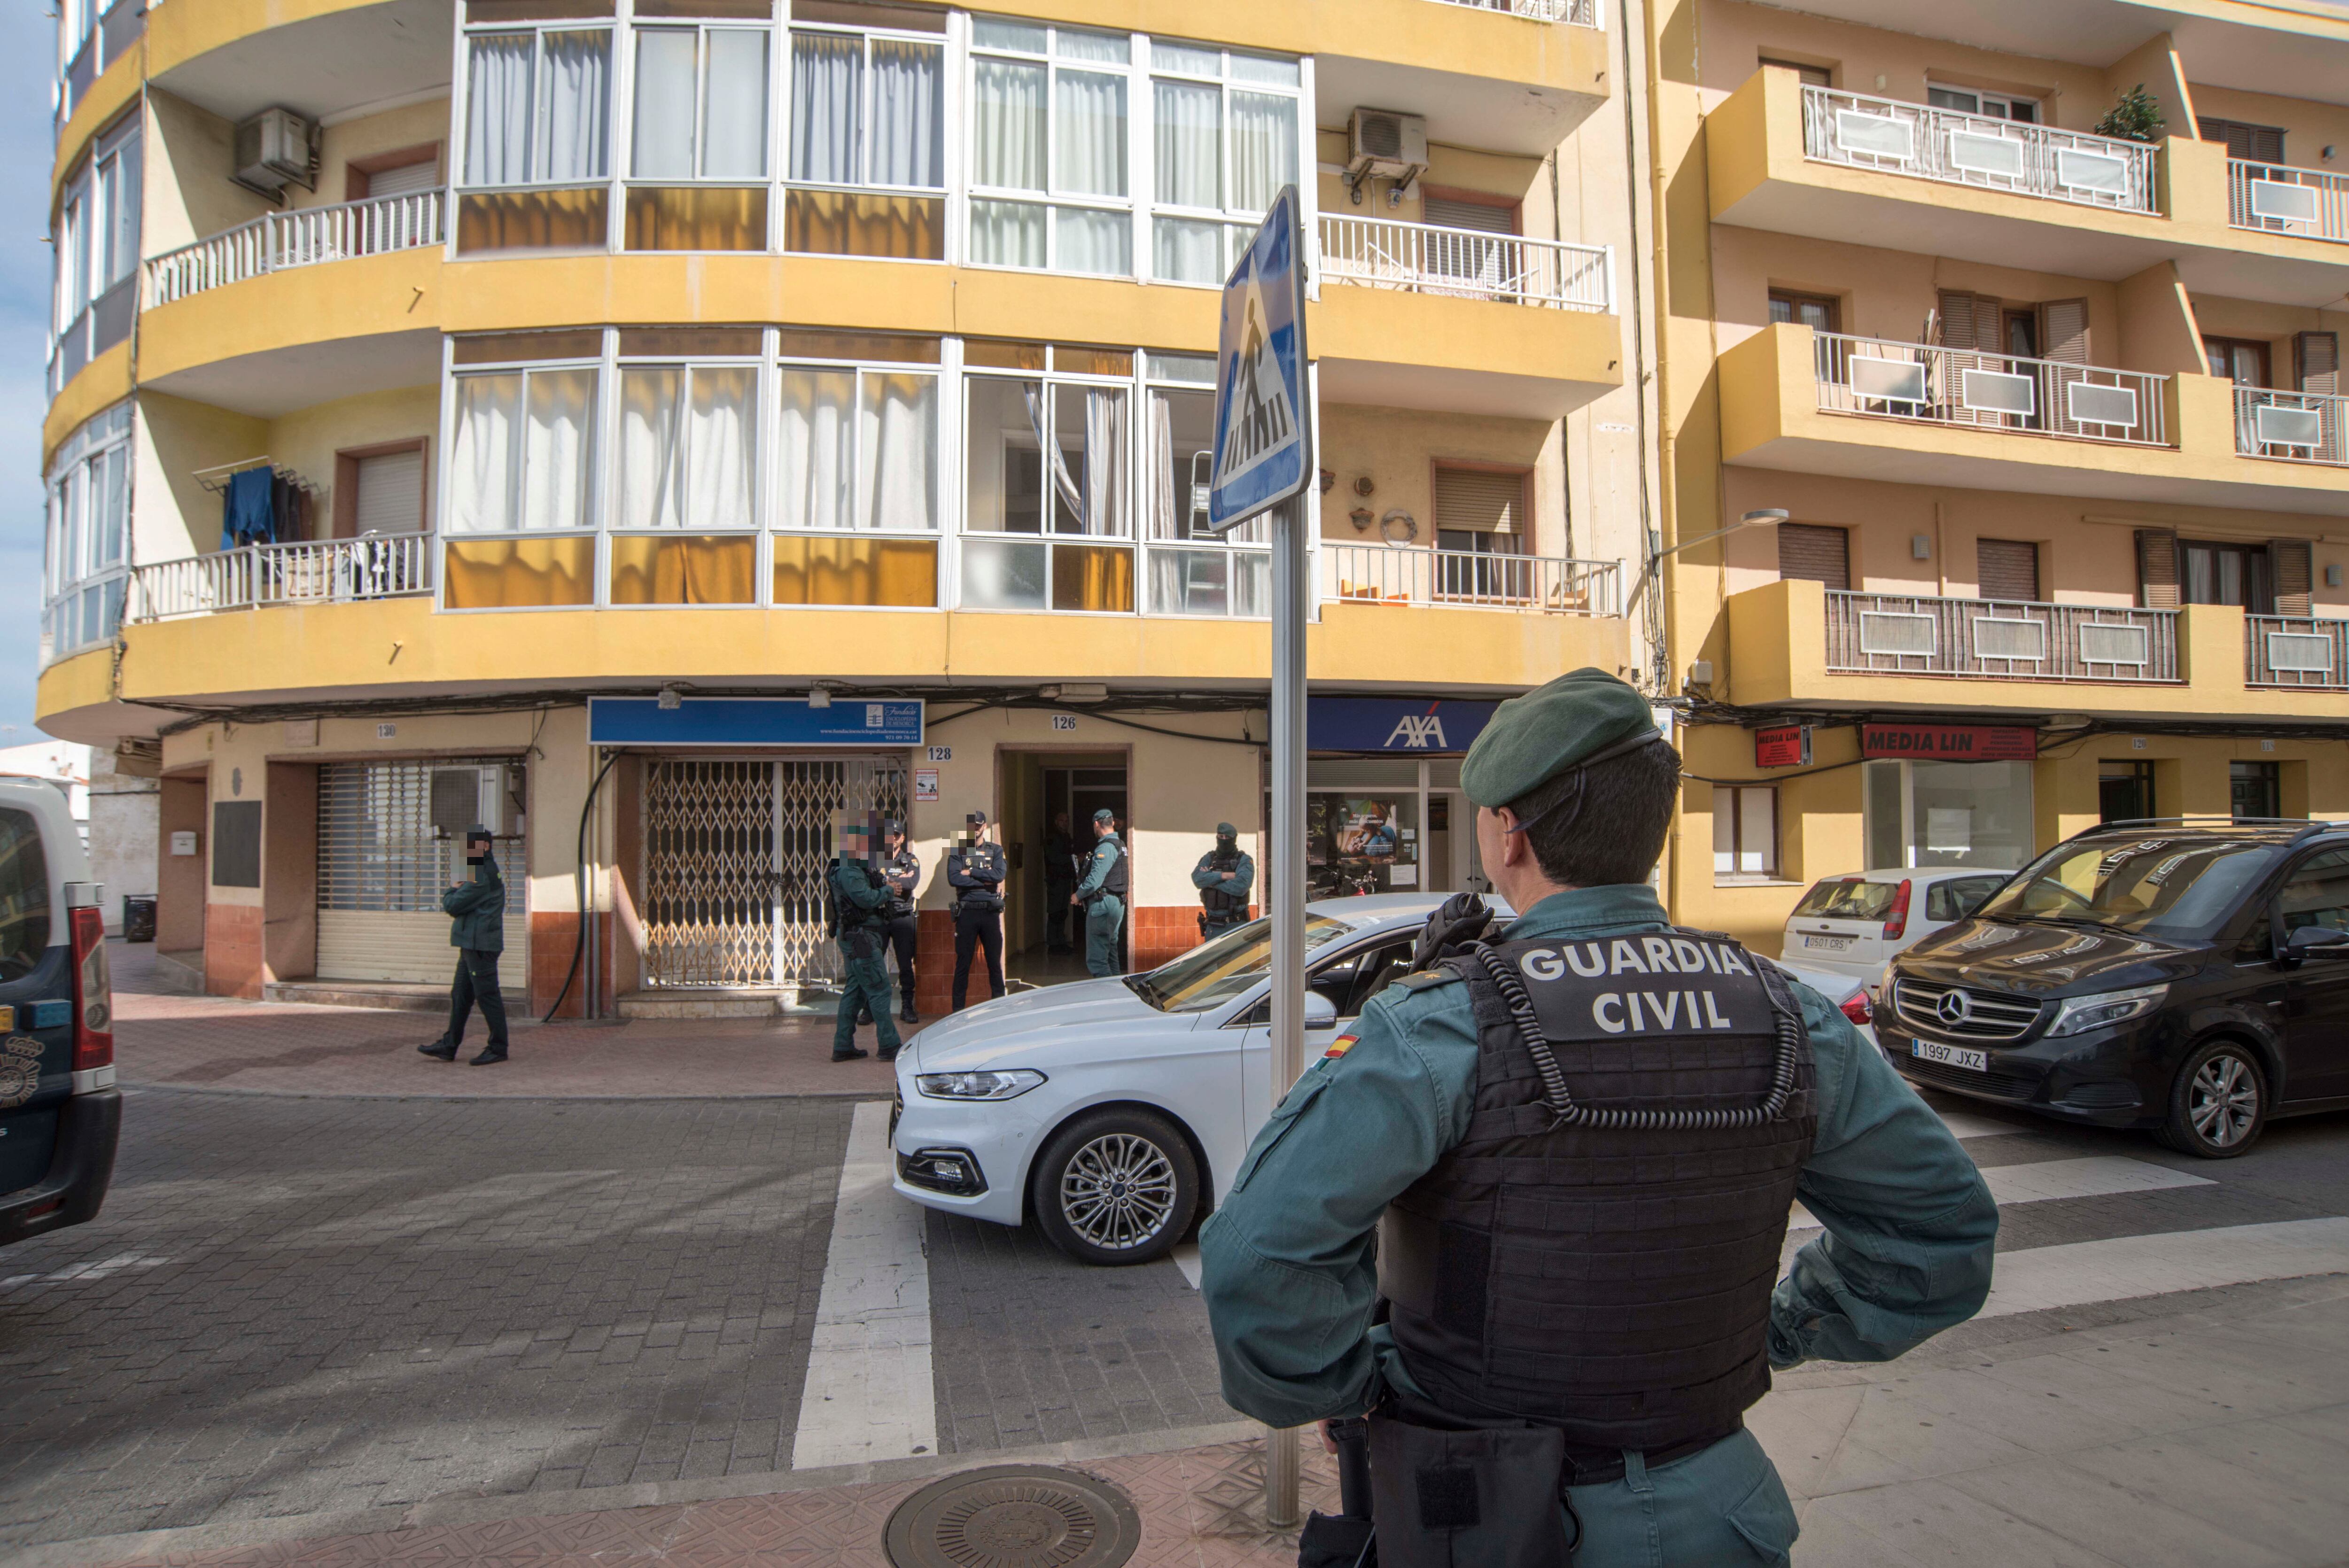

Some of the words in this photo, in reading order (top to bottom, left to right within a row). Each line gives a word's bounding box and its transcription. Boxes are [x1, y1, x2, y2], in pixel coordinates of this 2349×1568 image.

[885, 705, 918, 715] Fundació
[1053, 716, 1075, 729] 126
[379, 725, 395, 737] 130
[1383, 715, 1447, 747] AXA
[1758, 734, 1783, 744] MEDIA
[1786, 732, 1799, 741] LIN
[1867, 732, 1934, 751] MEDIA
[1940, 733, 1972, 751] LIN
[2133, 738, 2146, 748] 120
[928, 747, 951, 760] 128
[1810, 938, 1827, 947] 0501
[1830, 939, 1843, 948] CRS
[1520, 938, 1753, 980] GUARDIA
[1593, 991, 1731, 1033] CIVIL
[1923, 1043, 1951, 1061] 1997
[1956, 1051, 1981, 1068] JXZ
